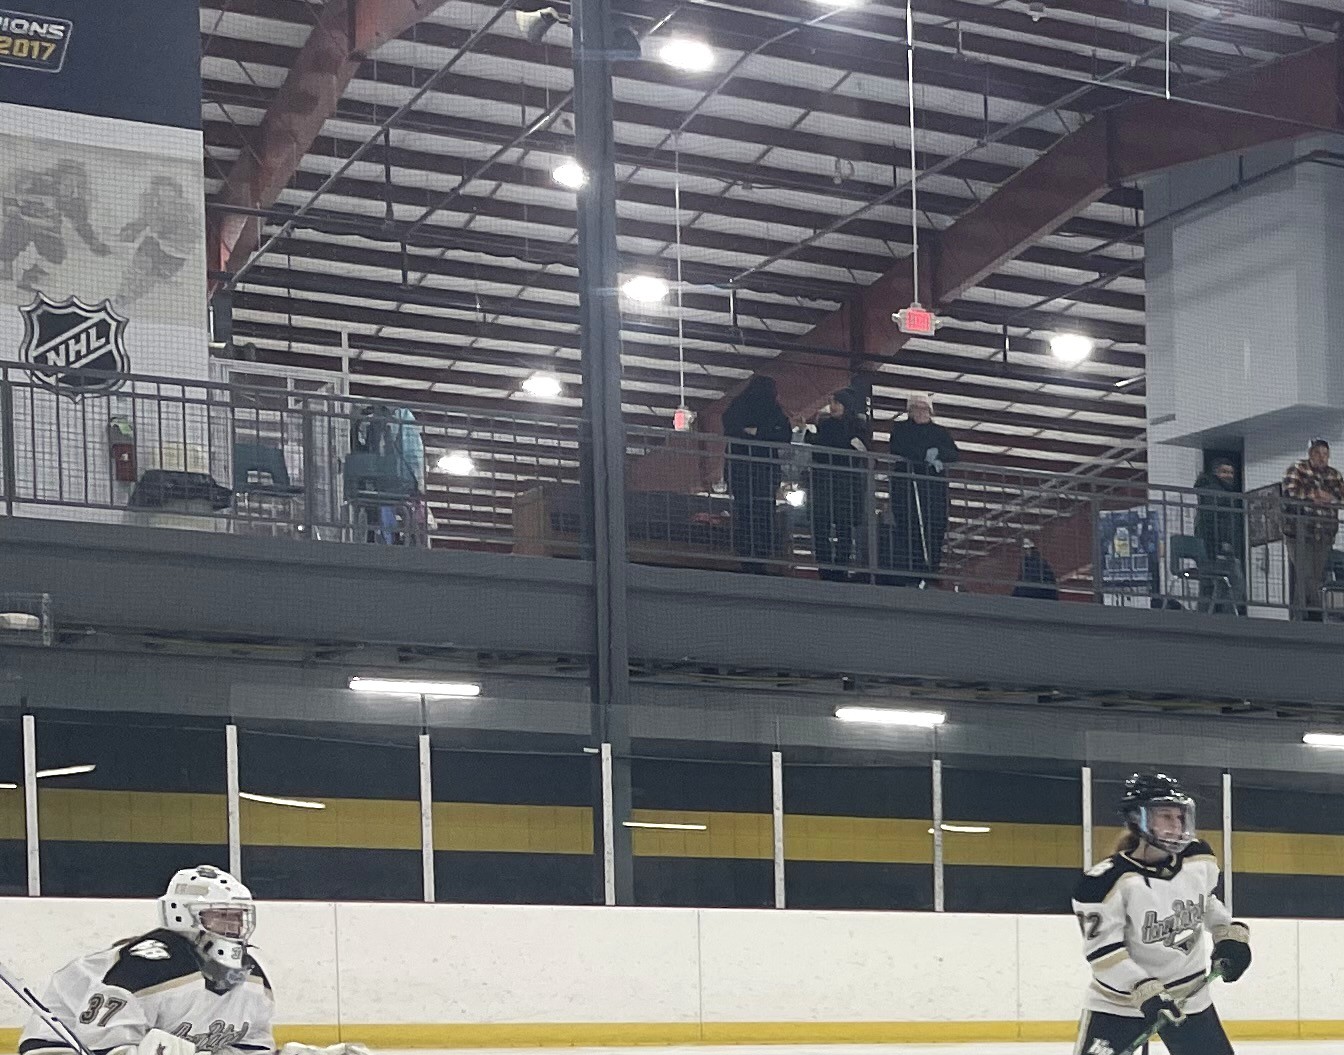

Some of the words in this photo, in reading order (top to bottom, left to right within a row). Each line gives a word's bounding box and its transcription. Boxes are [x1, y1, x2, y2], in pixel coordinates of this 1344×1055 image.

[0, 16, 65, 39] IONS
[0, 36, 56, 60] 2017
[46, 326, 106, 366] NHL
[80, 992, 128, 1028] 37
